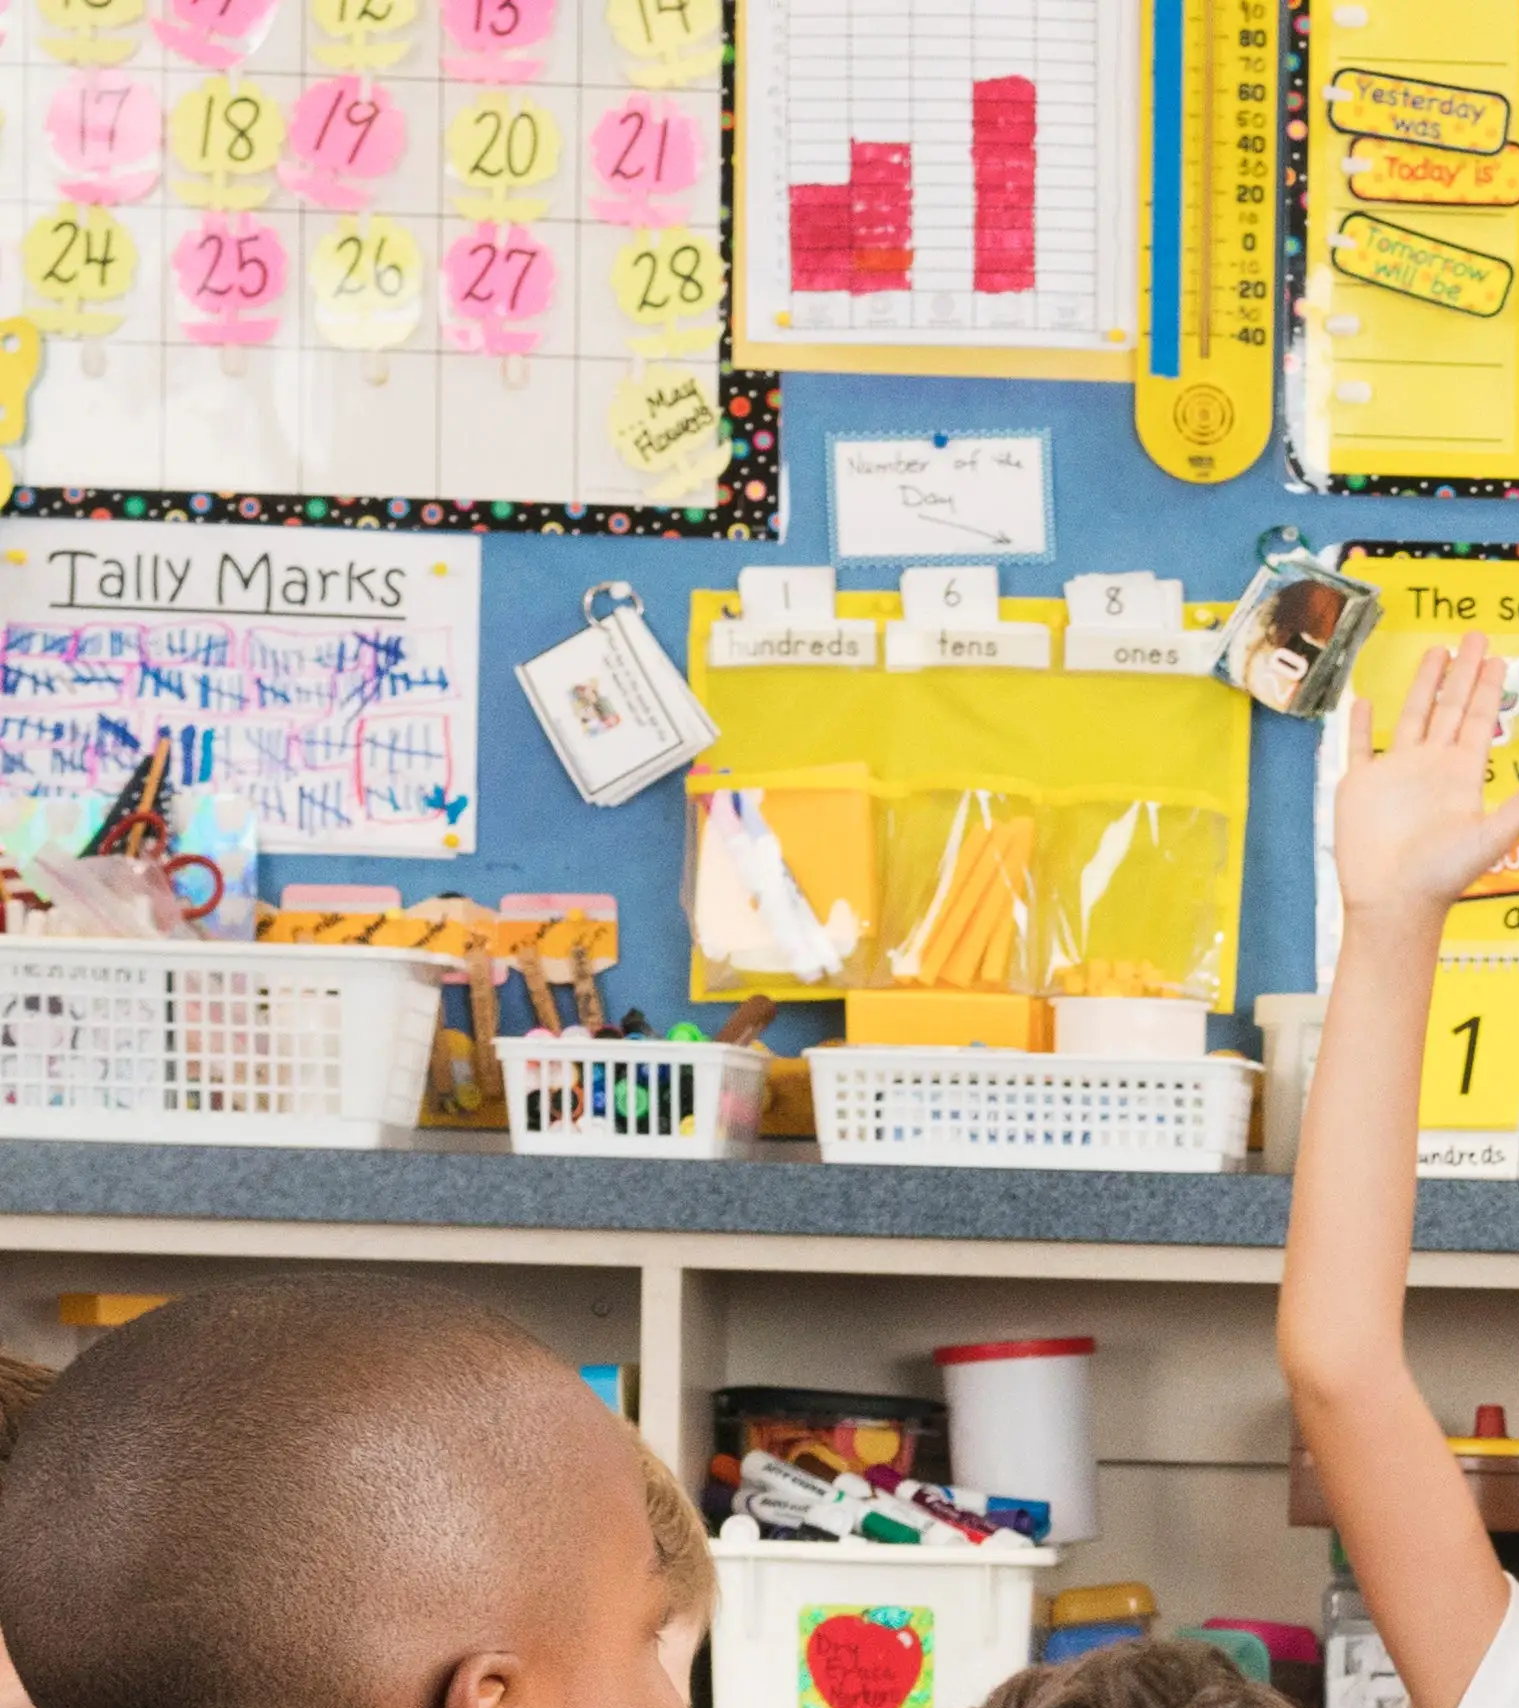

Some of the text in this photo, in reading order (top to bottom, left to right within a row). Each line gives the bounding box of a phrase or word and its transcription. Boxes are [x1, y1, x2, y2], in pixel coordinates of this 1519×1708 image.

[635, 0, 695, 43] 14
[1239, 29, 1267, 48] 80
[1238, 83, 1266, 101] 60
[1354, 74, 1486, 124] Yesterday
[74, 86, 671, 183] 17 18 19 20 21
[1236, 110, 1266, 129] 50
[1391, 114, 1443, 140] was
[1236, 135, 1266, 153] 40
[1384, 154, 1494, 188] Today is
[1236, 185, 1265, 204] 20
[1242, 233, 1256, 252] 0
[1363, 226, 1491, 284] Tomorrow
[41, 222, 704, 313] 24 25 26 27 28
[1374, 257, 1461, 302] will be
[846, 450, 1025, 478] Number of the
[899, 484, 956, 512] Day
[49, 548, 407, 610] Tally Marks
[943, 579, 963, 606] 6
[1104, 584, 1124, 615] 8
[1408, 586, 1478, 621] The
[728, 624, 1181, 667] hundreds tens ones
[1450, 1015, 1482, 1097] 1
[1417, 1146, 1507, 1165] undreds
